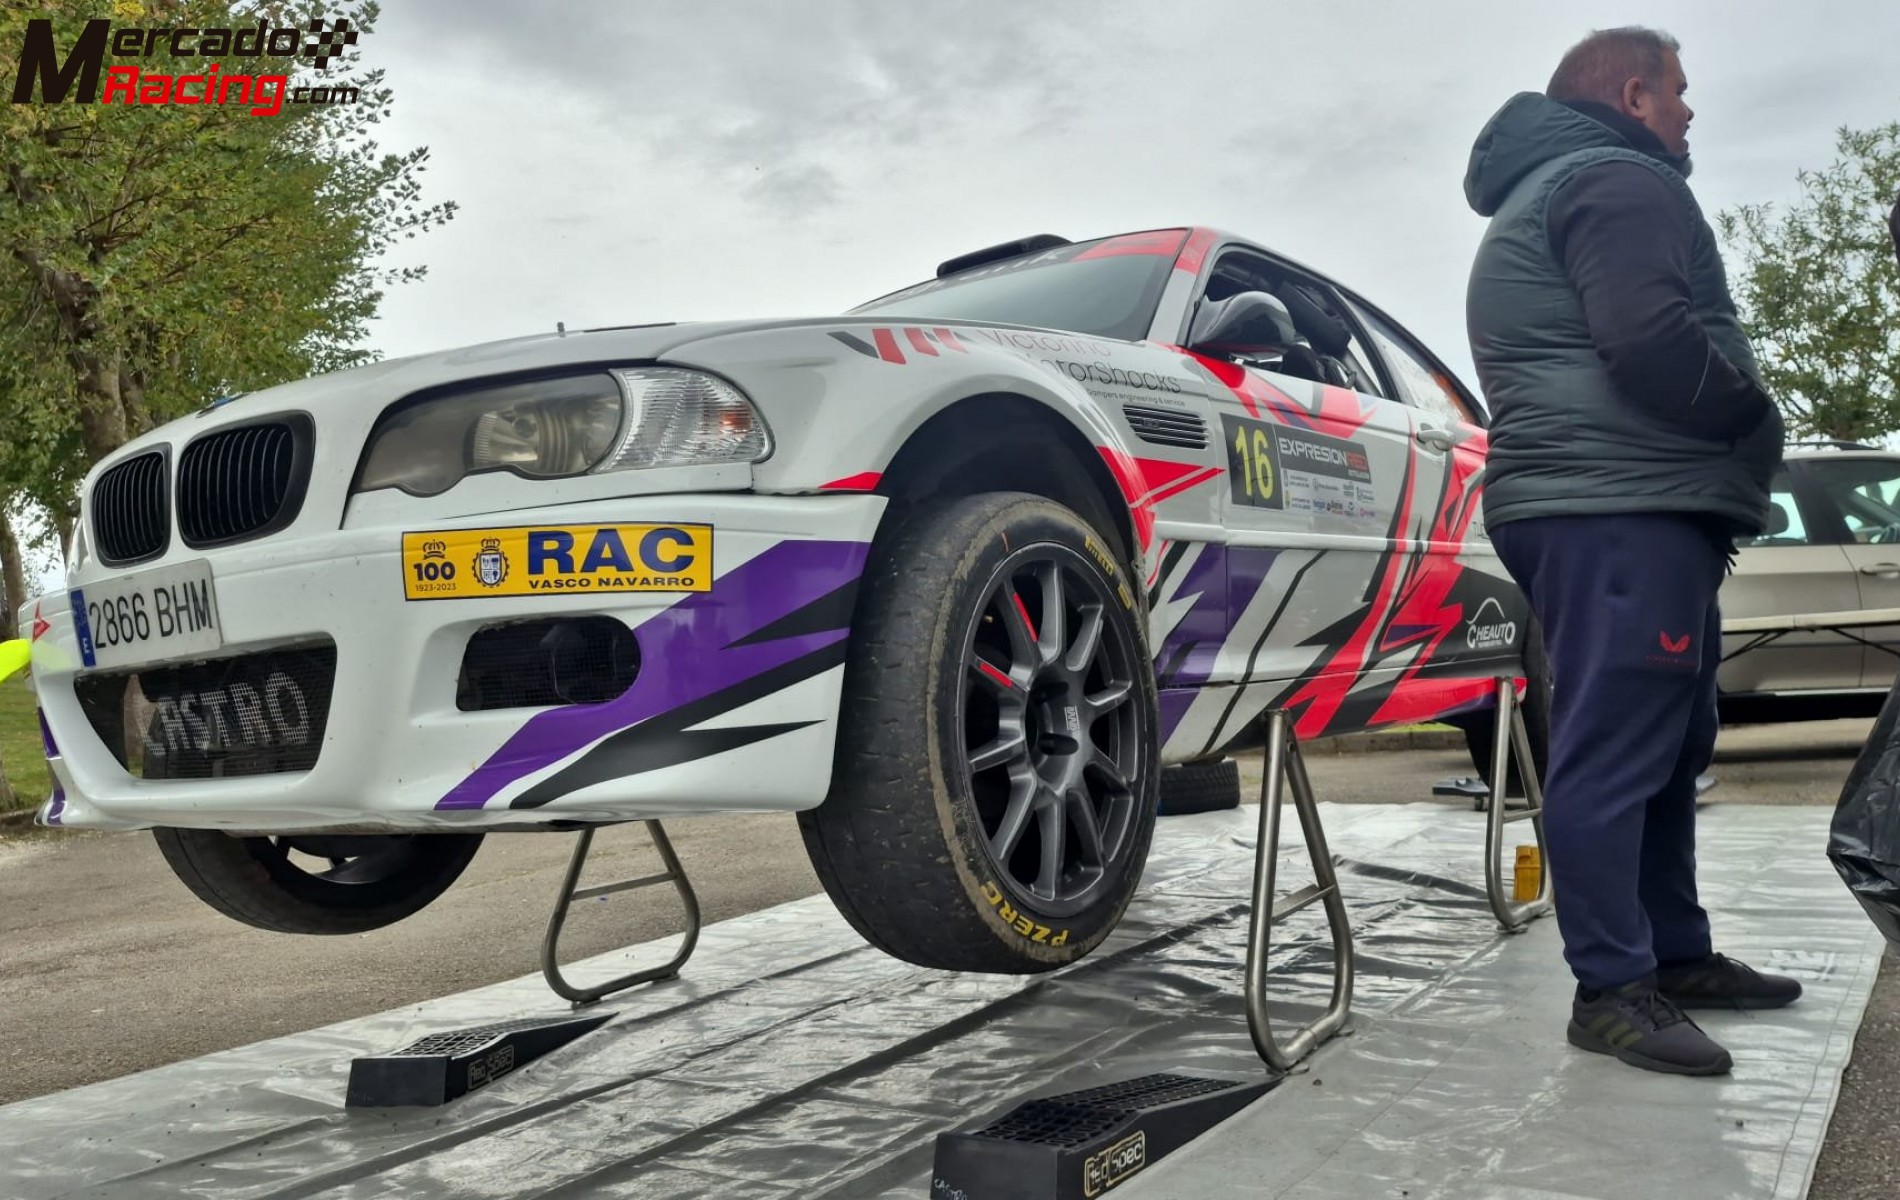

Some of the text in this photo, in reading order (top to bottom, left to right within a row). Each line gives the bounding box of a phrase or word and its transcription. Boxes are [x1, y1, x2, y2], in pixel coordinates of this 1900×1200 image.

[976, 328, 1112, 357] Victorino
[1039, 358, 1181, 393] otorShocks
[1235, 425, 1274, 499] 16
[527, 527, 695, 575] RAC
[413, 561, 456, 581] 100
[528, 576, 695, 589] VASCO NAVARRO
[415, 583, 457, 592] 1923-2023
[88, 578, 213, 650] 2866 BHM
[1466, 621, 1516, 649] CHEAUTO
